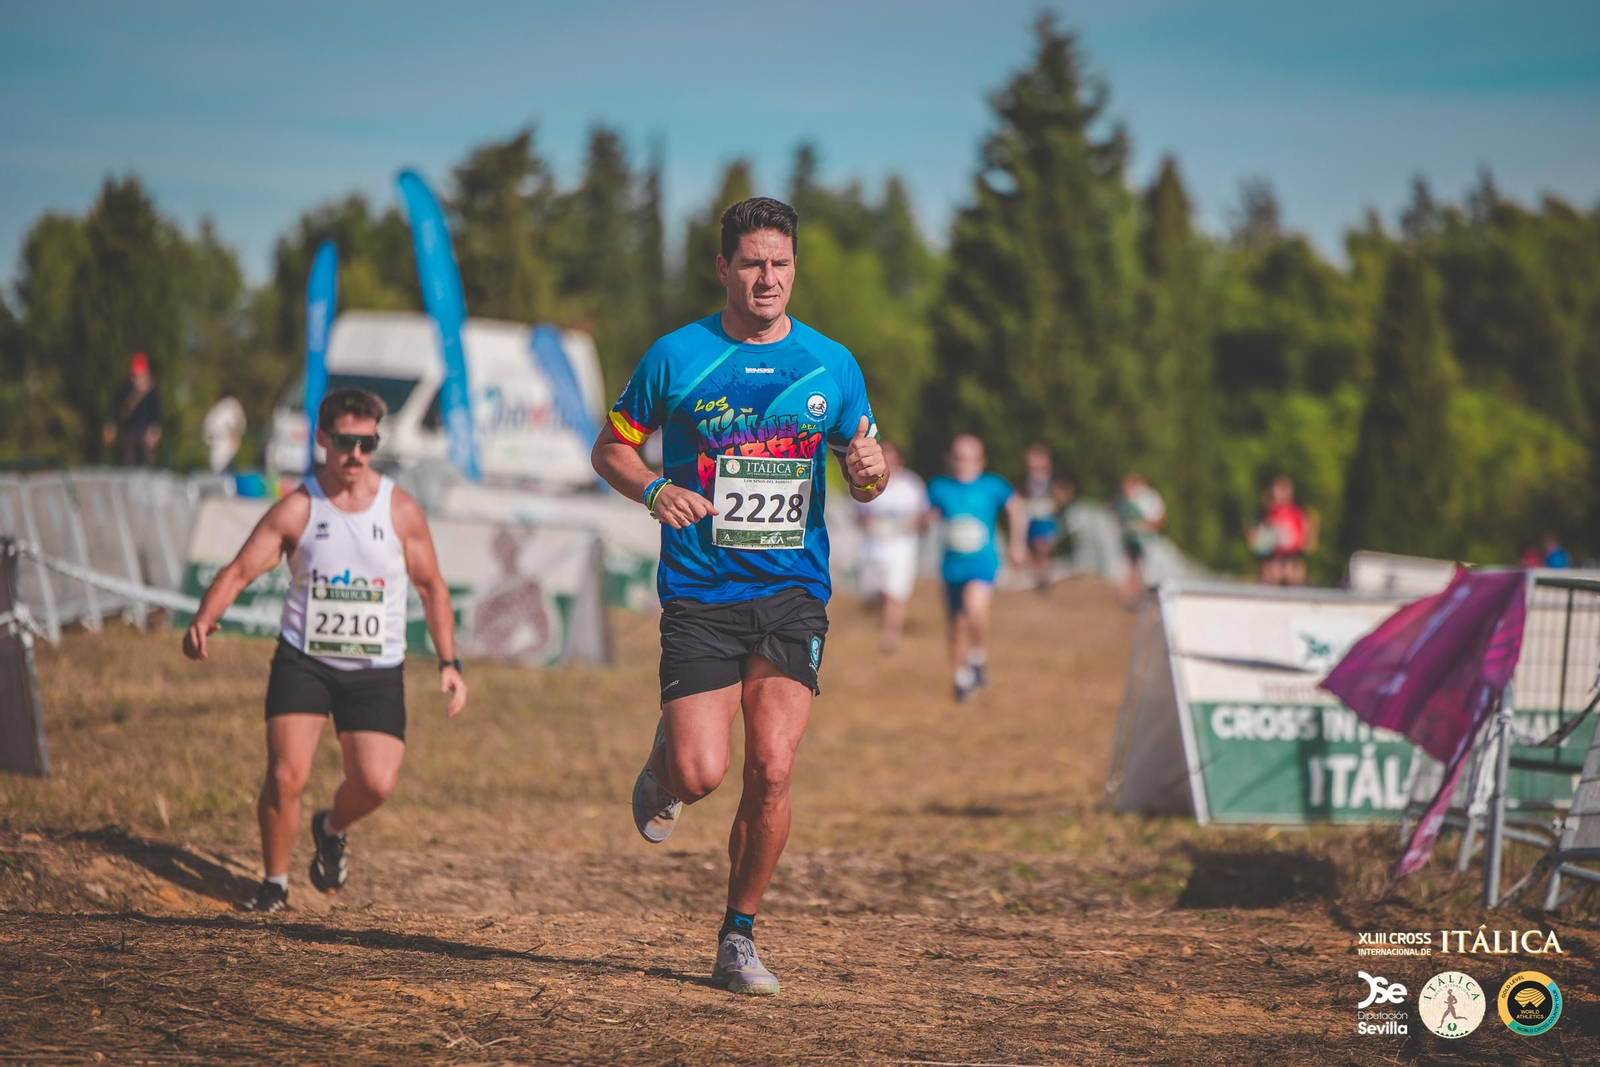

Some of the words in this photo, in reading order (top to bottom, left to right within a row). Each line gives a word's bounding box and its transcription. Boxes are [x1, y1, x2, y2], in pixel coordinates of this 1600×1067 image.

[694, 396, 729, 413] LOS
[747, 460, 792, 474] ITÁLICA
[724, 492, 804, 523] 2228
[315, 612, 380, 638] 2210
[1211, 706, 1319, 741] CROSS
[1308, 743, 1412, 810] ITÁL
